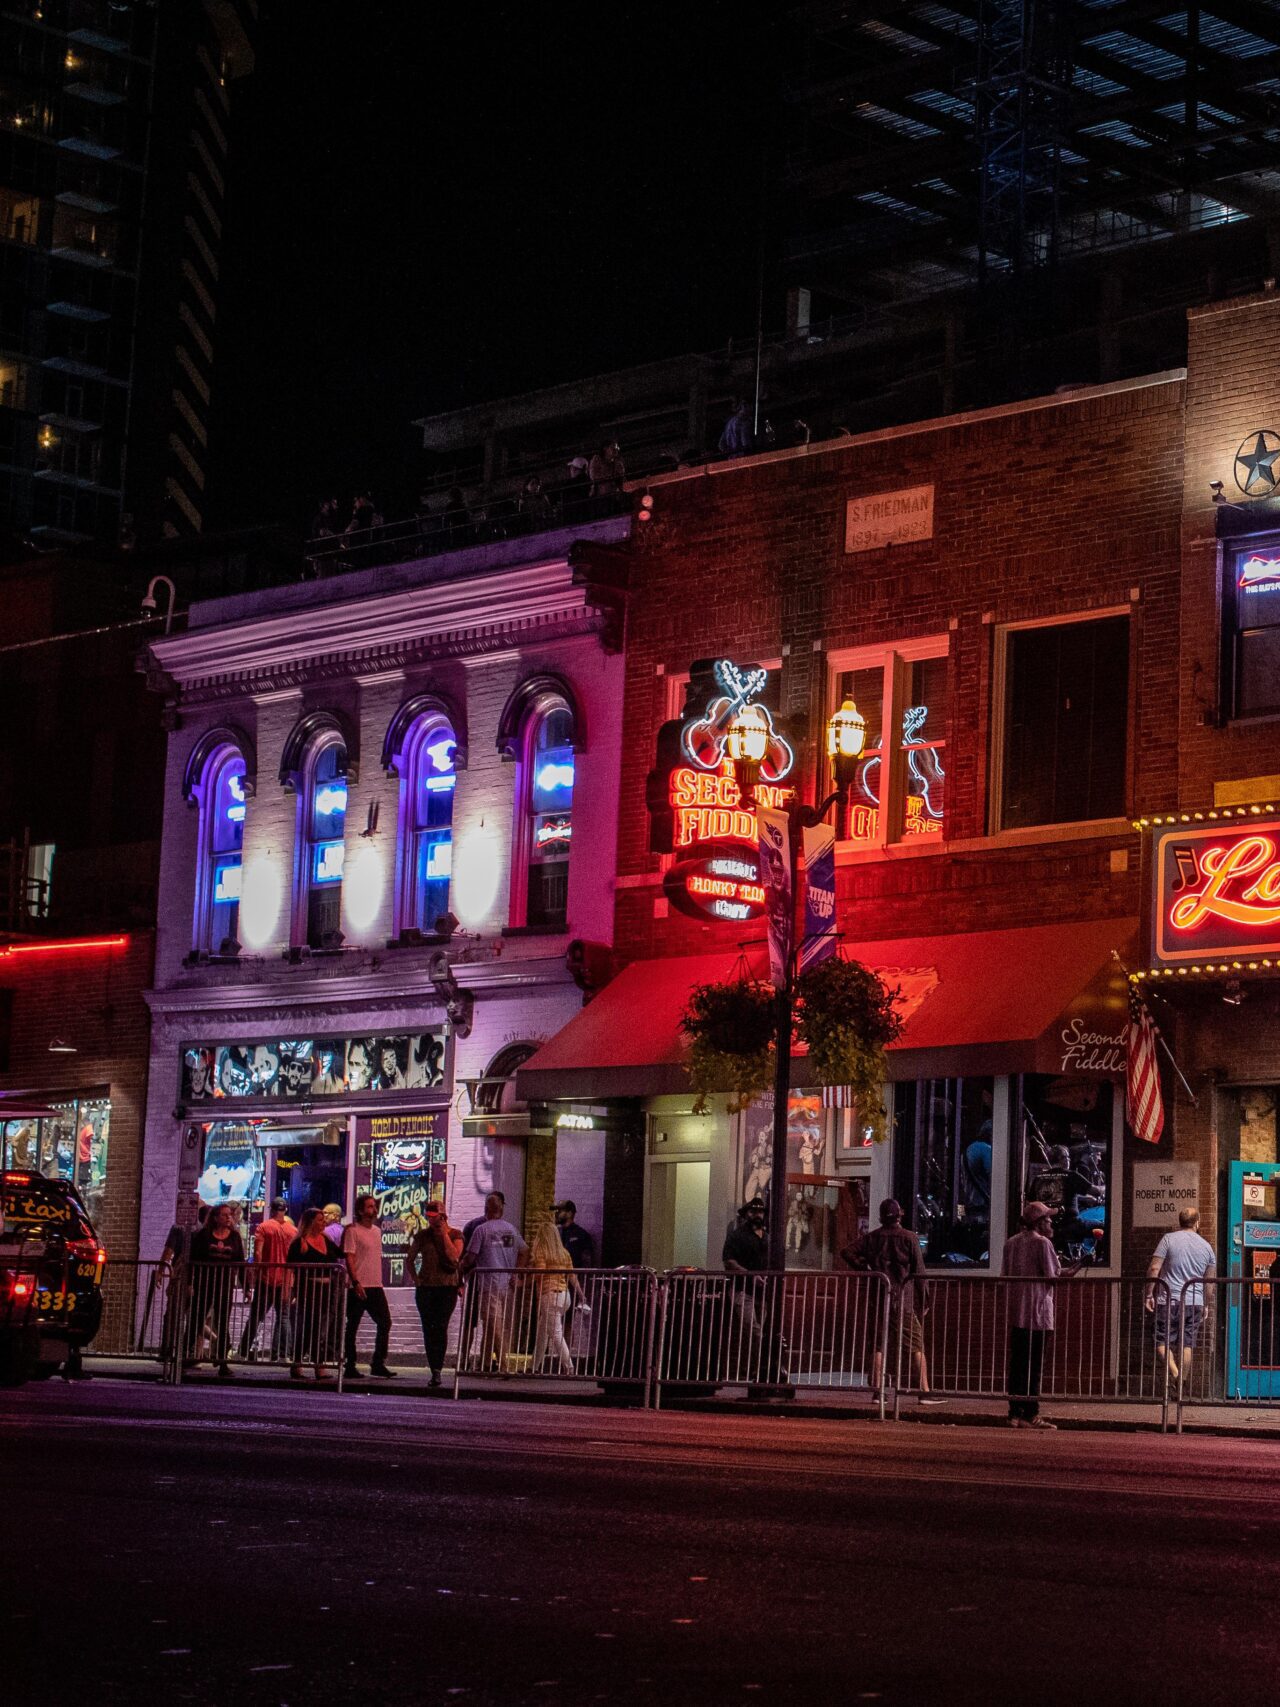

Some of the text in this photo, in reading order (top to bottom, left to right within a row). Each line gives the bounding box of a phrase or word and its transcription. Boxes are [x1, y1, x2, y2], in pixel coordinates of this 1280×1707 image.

[671, 768, 797, 808] SECN
[675, 807, 760, 847] FIDD
[691, 876, 738, 897] HONKY
[808, 886, 835, 906] TITAN
[818, 907, 834, 919] UP
[1061, 1018, 1129, 1045] Second
[1061, 1045, 1128, 1072] Fiddle
[556, 1114, 593, 1129] ATM
[1159, 1175, 1174, 1185] THE
[372, 1184, 428, 1219] Tootsies
[1135, 1188, 1197, 1200] ROBERT MOORE
[21, 1198, 72, 1221] taxi
[1154, 1203, 1177, 1213] BLDG.
[381, 1233, 410, 1246] OUNGE
[77, 1263, 96, 1277] 620
